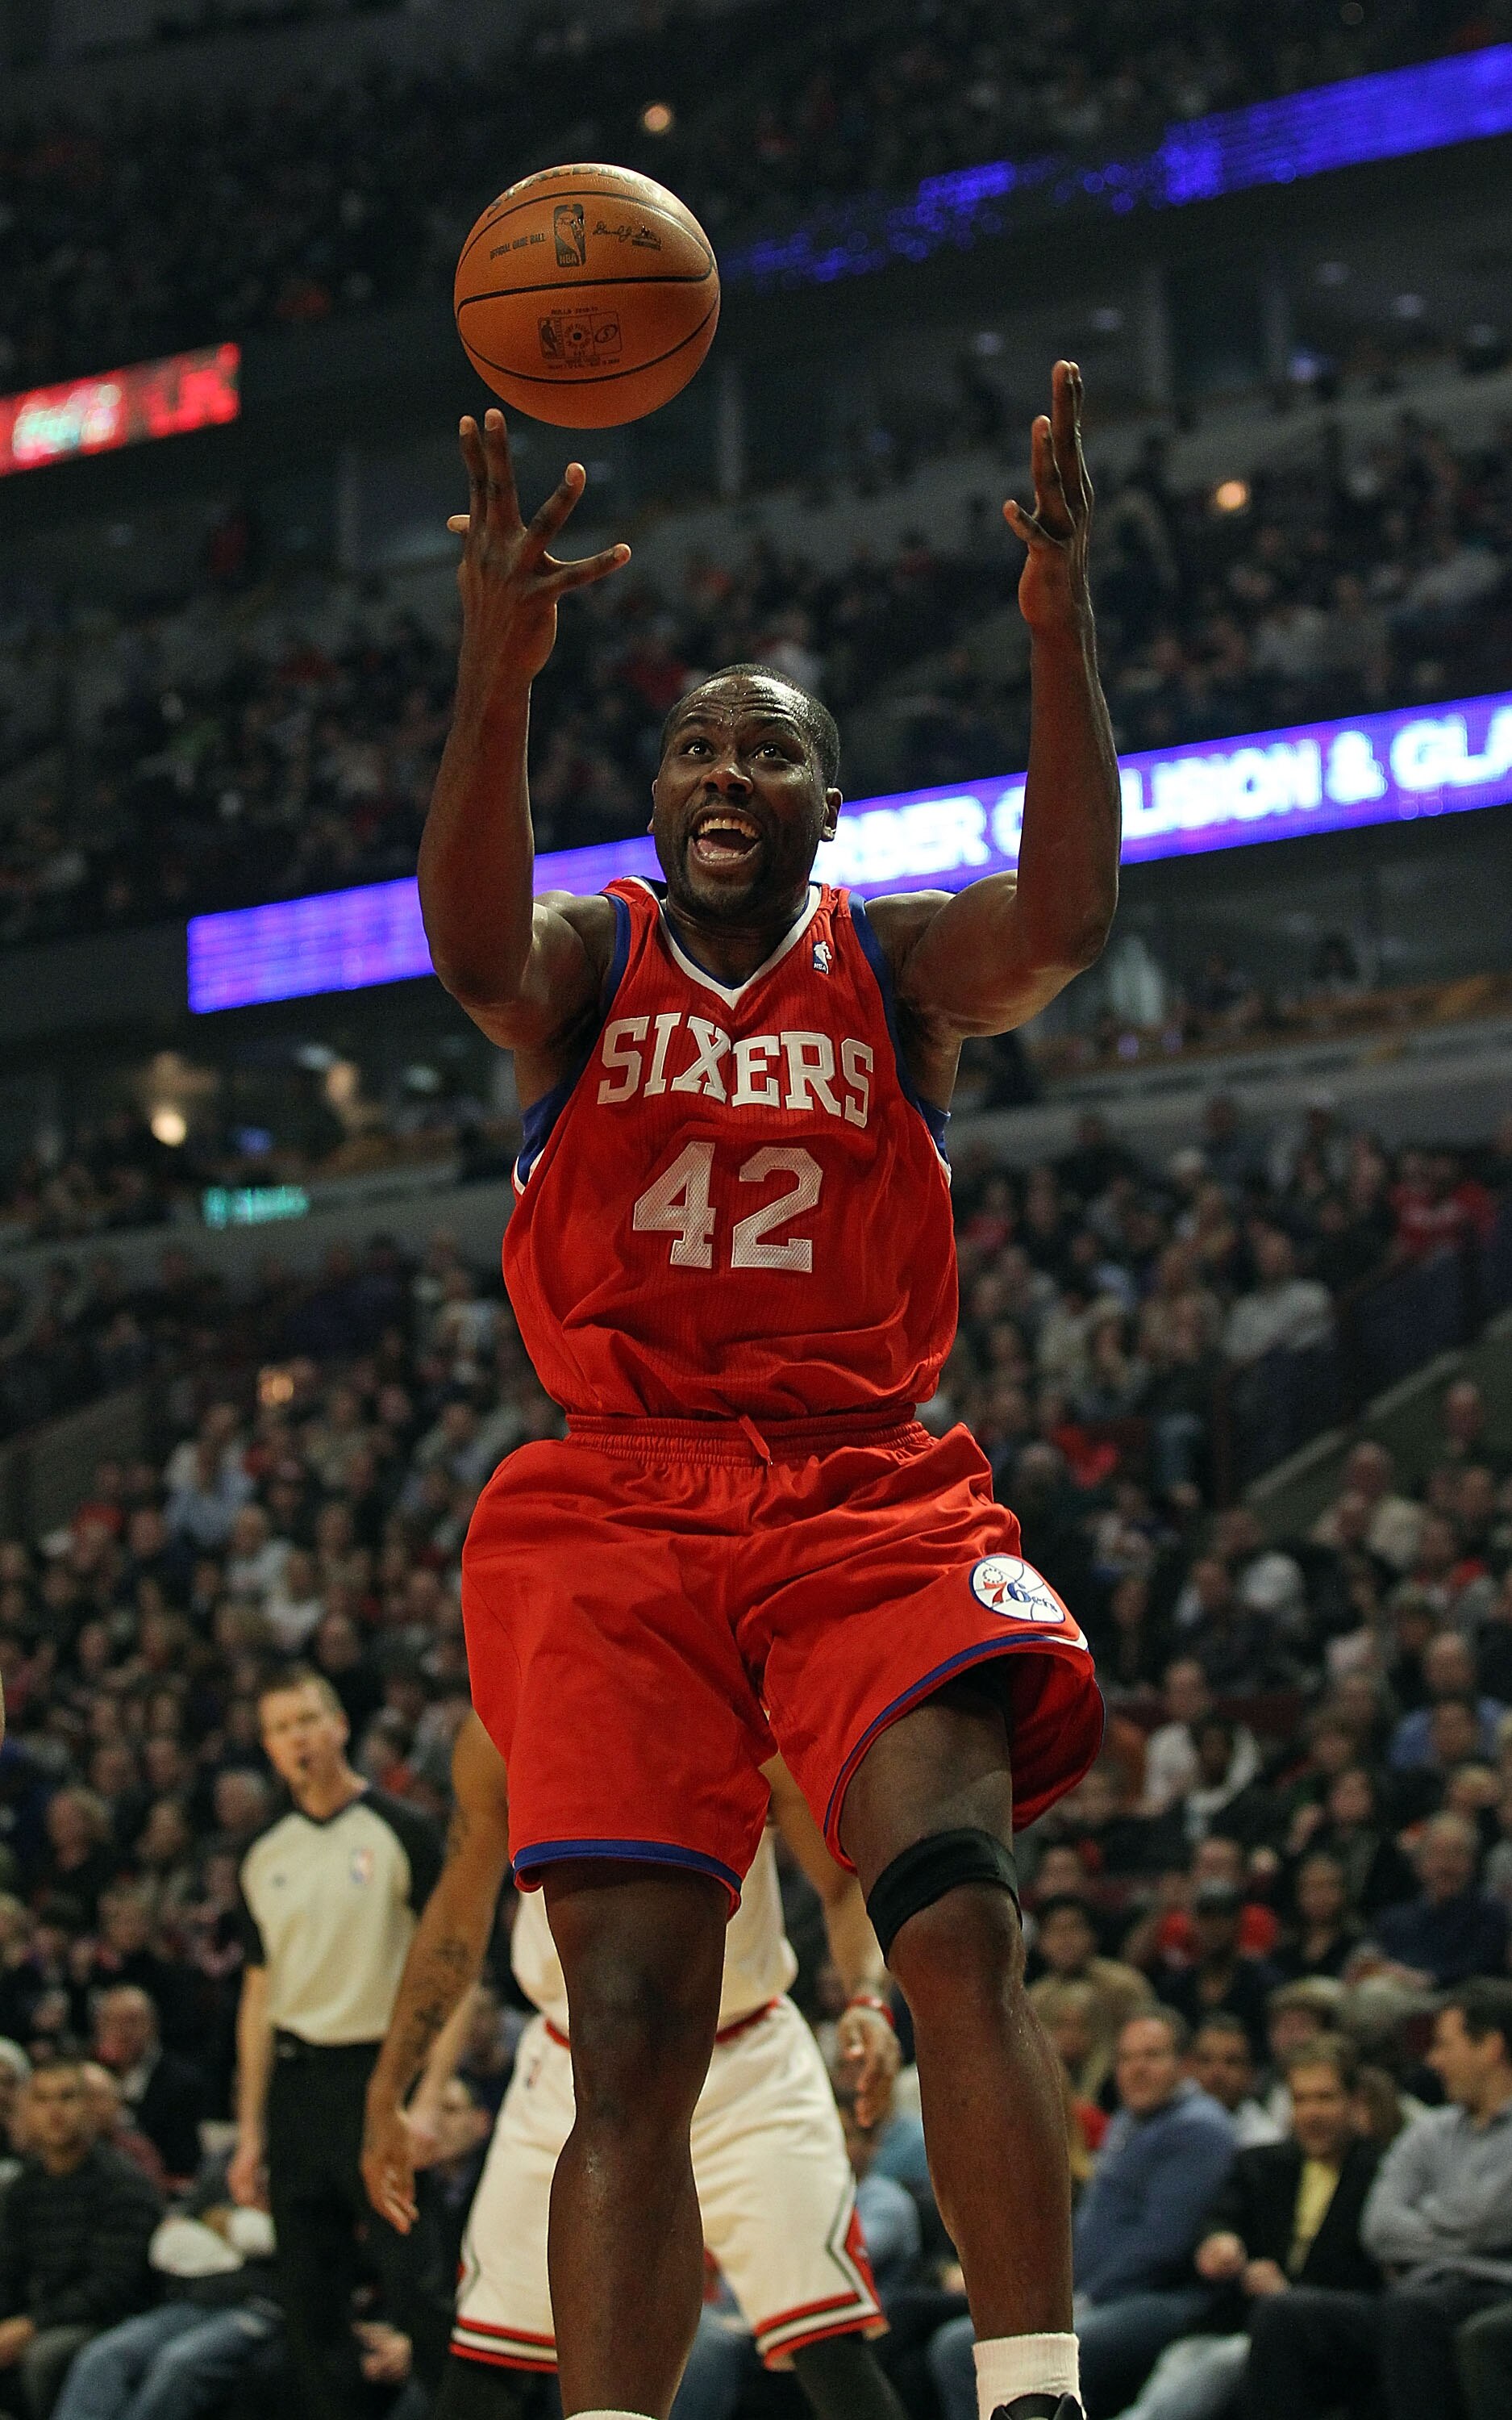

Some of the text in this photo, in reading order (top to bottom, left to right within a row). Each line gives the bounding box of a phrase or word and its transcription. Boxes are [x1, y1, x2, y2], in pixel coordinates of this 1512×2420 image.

[559, 254, 577, 265] NBA
[1325, 729, 1388, 805] &
[814, 962, 827, 971] NBA
[597, 1012, 873, 1129] SIXERS
[632, 1141, 823, 1273] 42
